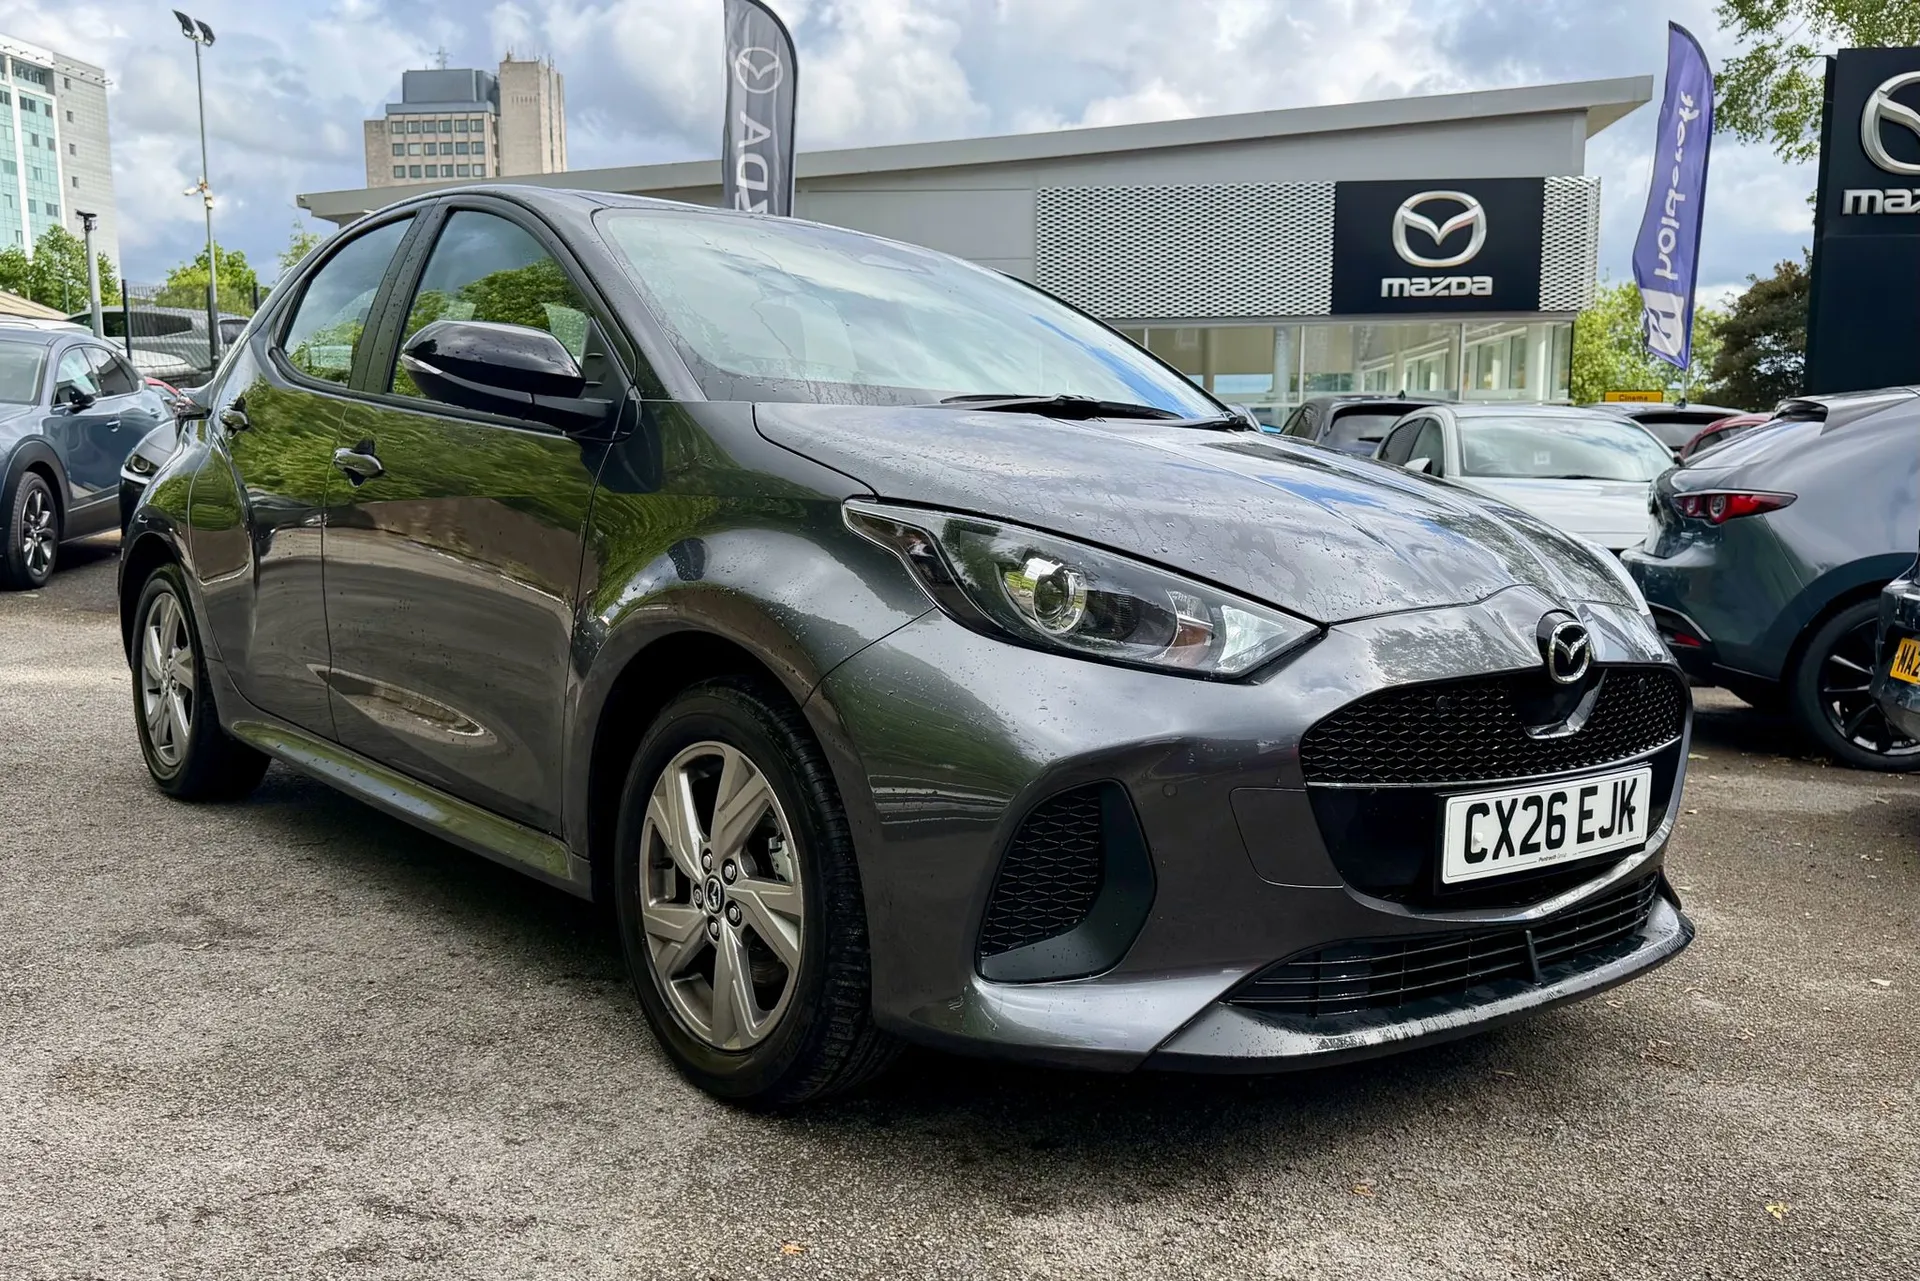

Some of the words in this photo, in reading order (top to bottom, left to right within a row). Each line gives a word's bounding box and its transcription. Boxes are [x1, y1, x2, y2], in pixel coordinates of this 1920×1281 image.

[1842, 188, 1920, 215] ma
[1619, 394, 1648, 402] Cinema
[1463, 791, 1568, 865] CX26
[1576, 777, 1638, 844] EJK
